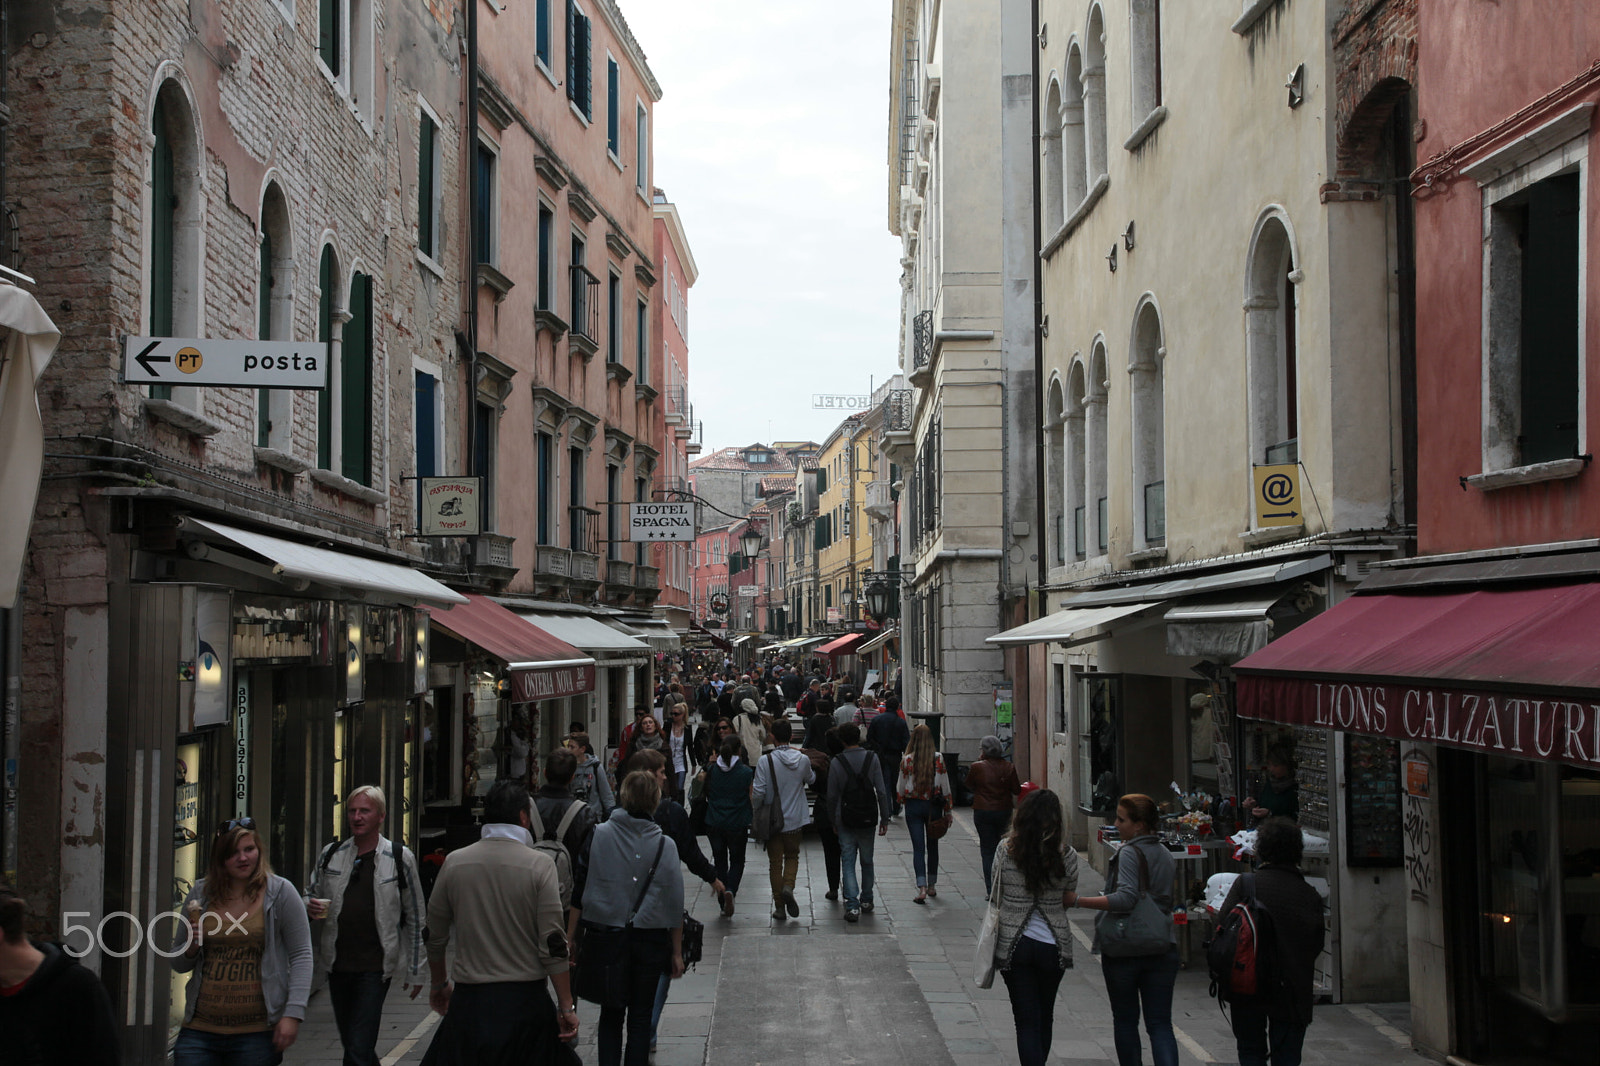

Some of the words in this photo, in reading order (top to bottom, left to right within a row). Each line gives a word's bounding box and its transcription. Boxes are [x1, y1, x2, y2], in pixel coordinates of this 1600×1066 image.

[178, 354, 200, 368] PT
[243, 352, 318, 373] posta
[1262, 473, 1295, 506] @
[632, 517, 691, 527] SPAGNA
[636, 505, 688, 515] HOTEL
[524, 671, 555, 698] OSTERIA
[555, 670, 574, 694] NOVA
[1314, 683, 1387, 733] LIONS
[237, 687, 246, 800] applicazione
